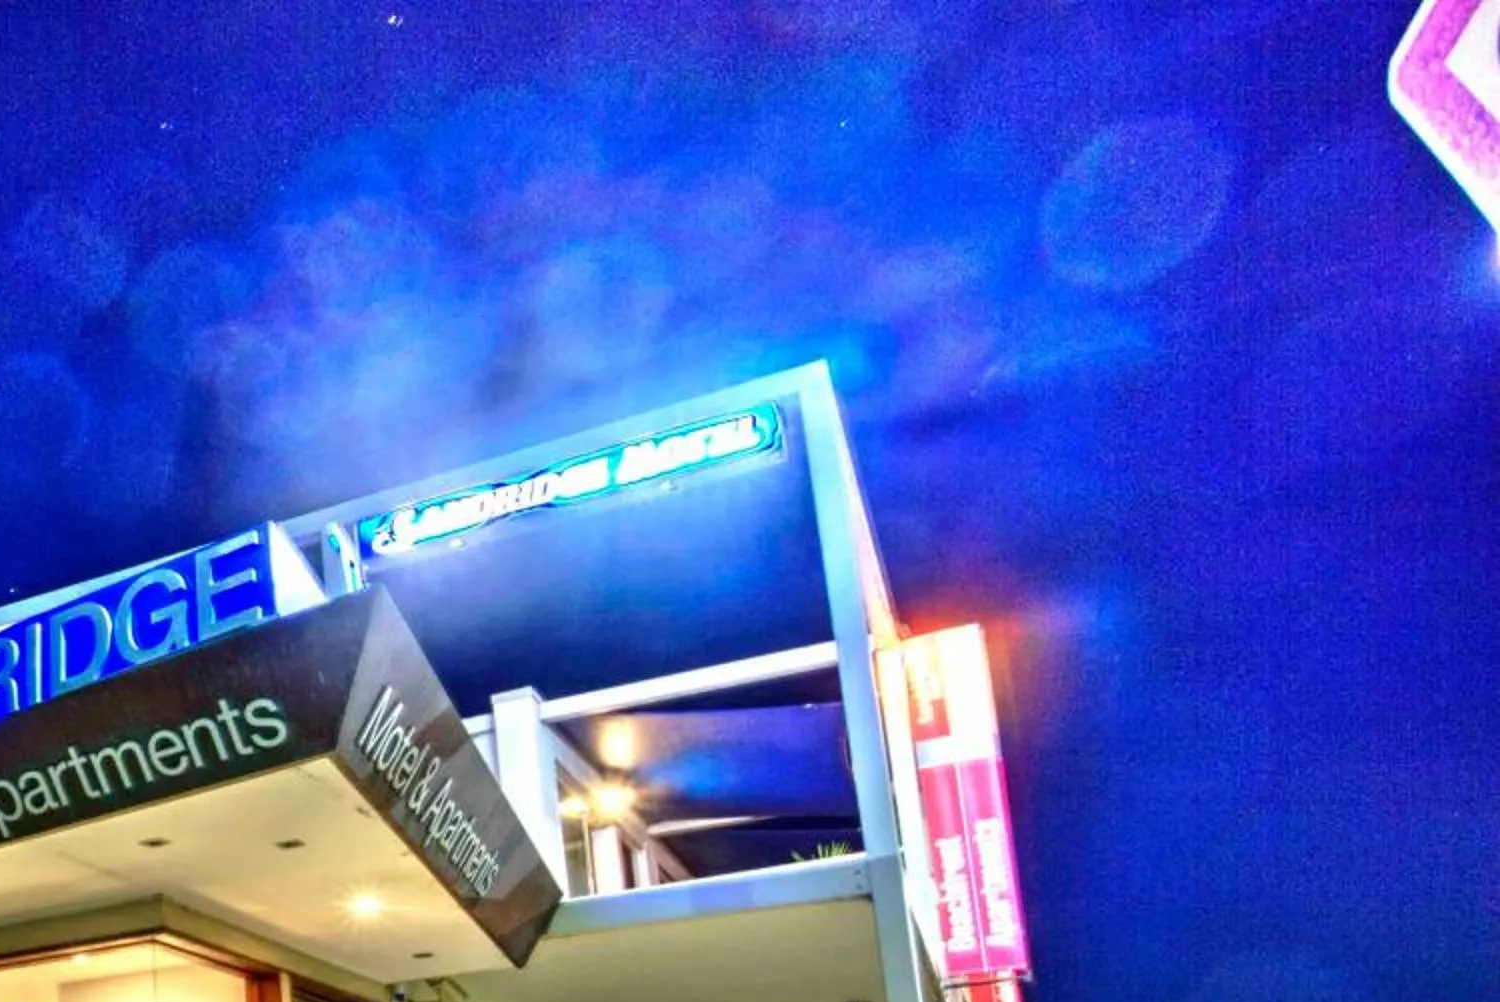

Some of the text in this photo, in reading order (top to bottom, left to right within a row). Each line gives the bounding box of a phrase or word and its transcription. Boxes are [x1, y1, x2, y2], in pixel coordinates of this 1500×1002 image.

[358, 685, 500, 898] Motel & Apartments
